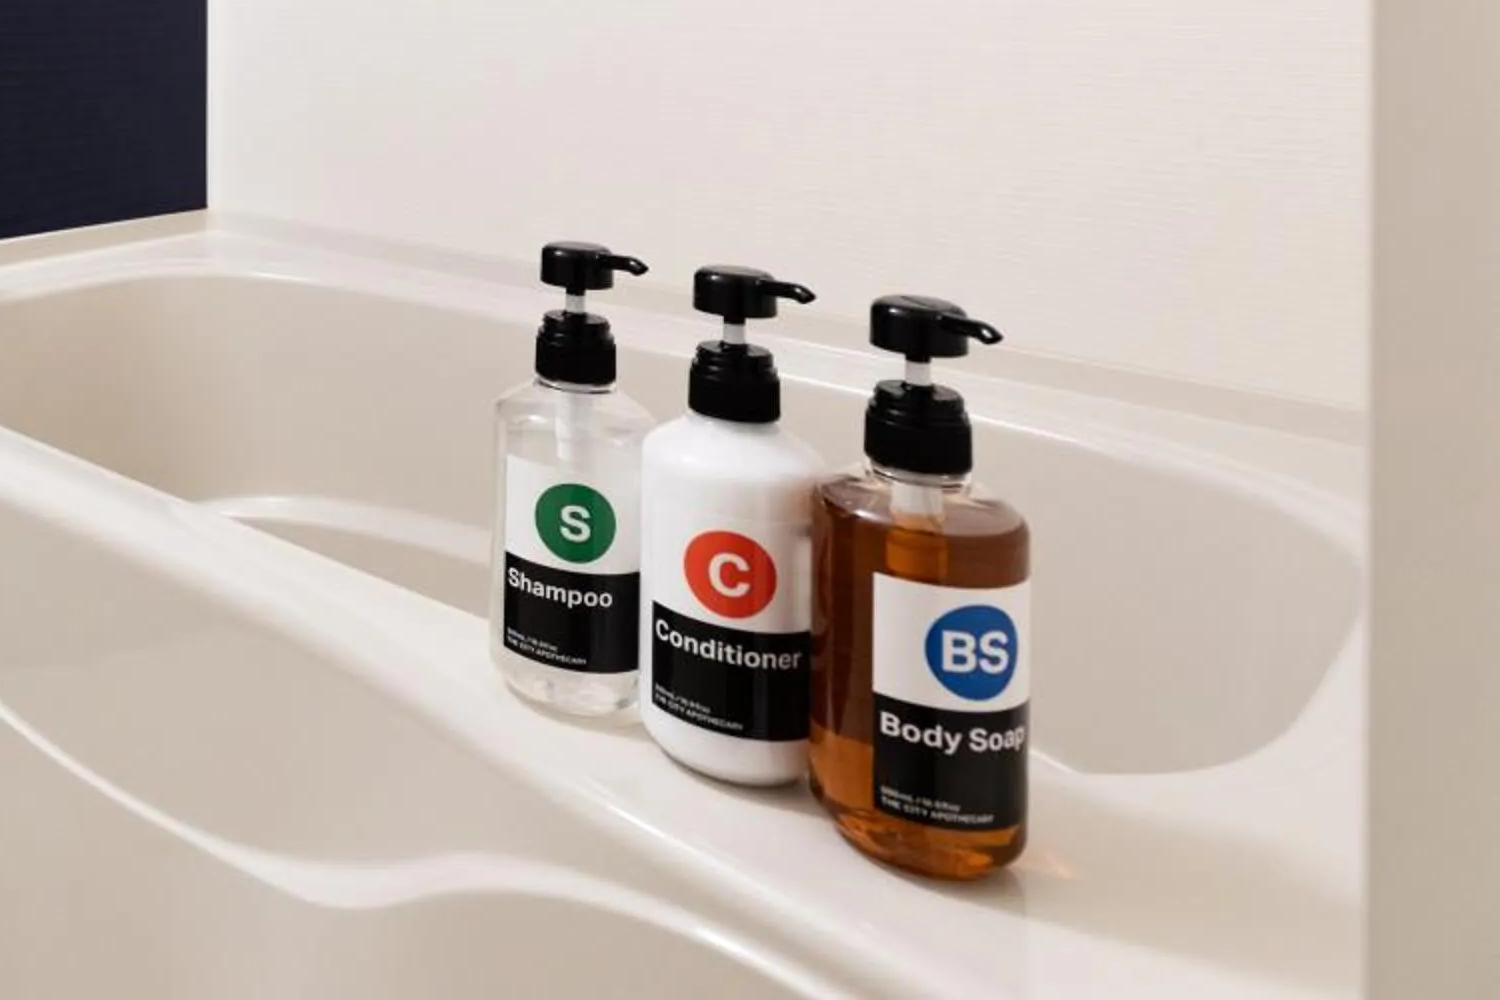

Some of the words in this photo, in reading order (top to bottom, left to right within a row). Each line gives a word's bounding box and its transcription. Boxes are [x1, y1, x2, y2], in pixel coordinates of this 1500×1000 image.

[559, 504, 592, 543] S
[507, 566, 614, 609] Shampoo
[708, 552, 751, 598] C
[655, 618, 803, 671] Conditioner
[941, 629, 1009, 674] BS
[879, 710, 962, 755] Body
[968, 725, 1027, 753] Soap
